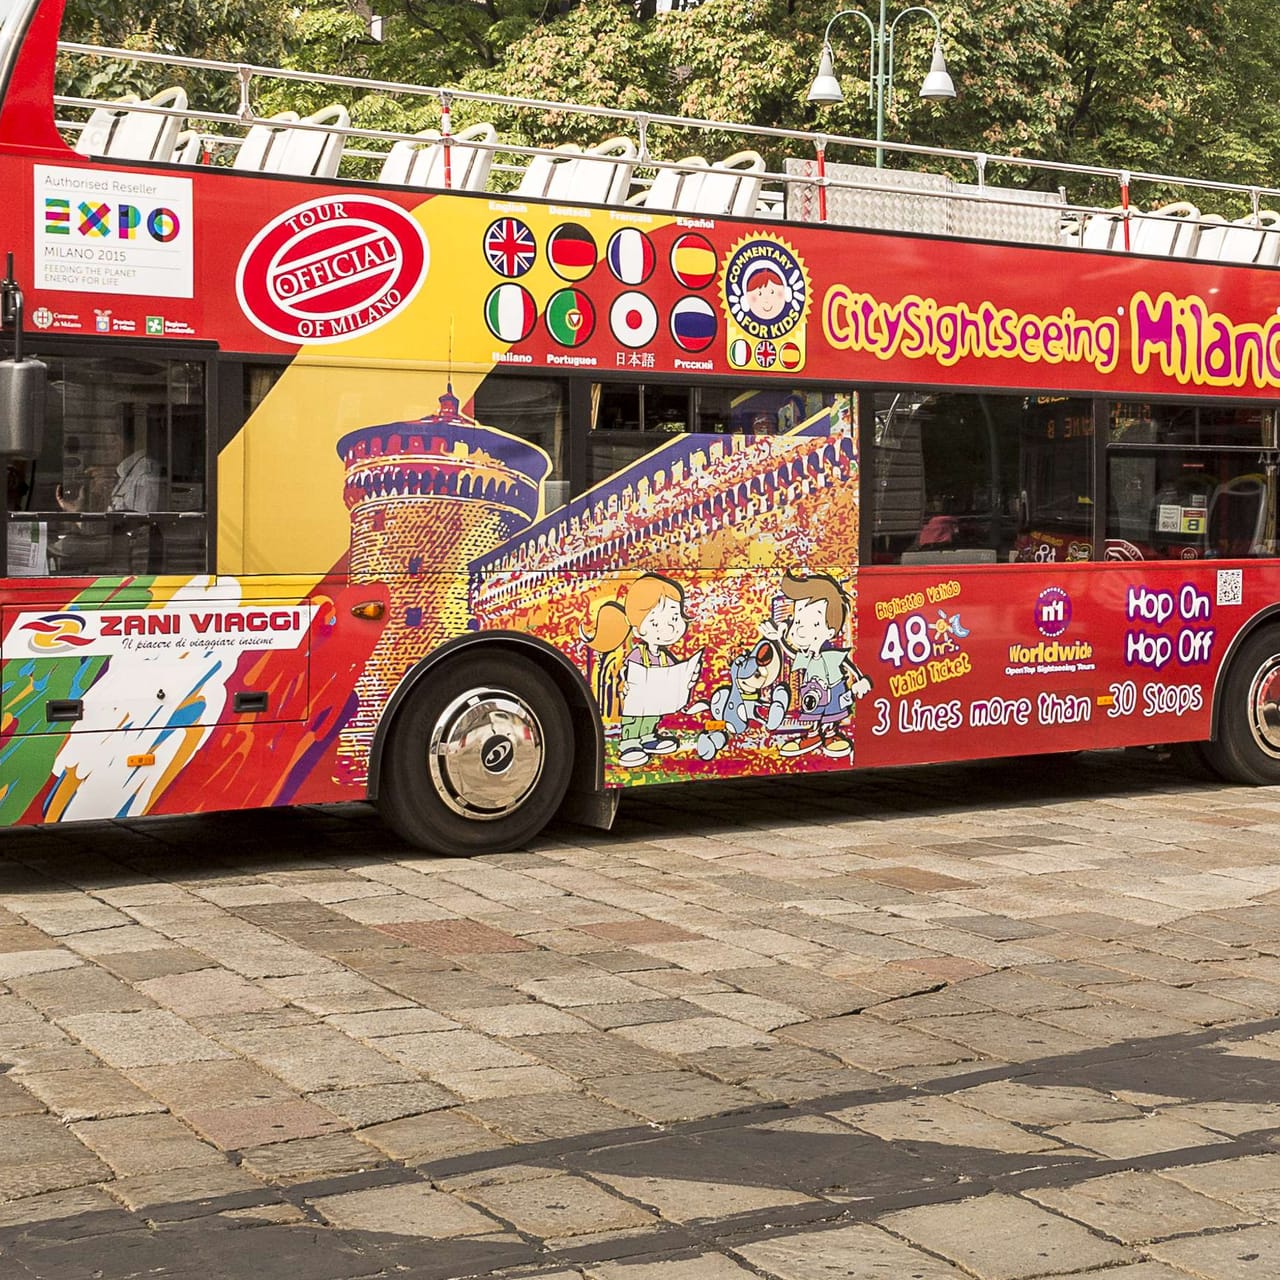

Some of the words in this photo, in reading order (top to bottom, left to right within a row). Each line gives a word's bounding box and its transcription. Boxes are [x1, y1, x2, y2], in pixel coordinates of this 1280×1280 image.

[44, 175, 109, 191] Authorised
[113, 181, 158, 195] Reseller
[45, 198, 180, 243] EXPO
[285, 202, 348, 234] TOUR
[676, 216, 715, 230] Español
[44, 246, 94, 260] MILANO
[98, 250, 127, 262] 2015
[276, 240, 397, 298] OFFICIAL
[729, 246, 794, 284] COMMENTARY
[44, 264, 83, 275] FEEDING
[85, 266, 102, 276] THE
[104, 267, 137, 278] PLANET
[44, 273, 79, 284] ENERGY
[82, 275, 100, 286] FOR
[102, 277, 119, 287] LIFE
[298, 319, 325, 337] OF
[330, 289, 402, 336] MILANO
[741, 315, 769, 338] FOR
[770, 308, 800, 338] KIDS
[822, 283, 1121, 373] CitySightseeing
[492, 352, 532, 365] Italiano
[616, 351, 656, 368] 日本語
[875, 591, 925, 620] Biglietto
[927, 581, 961, 606] Valido
[1127, 585, 1174, 624] Hop
[1180, 585, 1211, 620] On
[99, 615, 181, 637] ZANI
[189, 611, 300, 633] VIAGGI
[878, 610, 931, 669] 48
[121, 637, 132, 651] Il
[134, 639, 172, 651] piacere
[174, 637, 188, 649] di
[189, 637, 236, 651] viaggiare
[238, 636, 275, 648] insieme
[1009, 641, 1093, 663] Worldwide
[1126, 628, 1174, 668] Hop
[1177, 627, 1215, 664] Off
[889, 667, 925, 697] Valid
[927, 653, 972, 686] Ticket
[872, 698, 891, 736] 3
[898, 698, 963, 733] Lines
[970, 694, 1031, 727] more
[1038, 692, 1092, 726] than
[1107, 680, 1136, 718] 30
[1142, 681, 1203, 716] Stops
